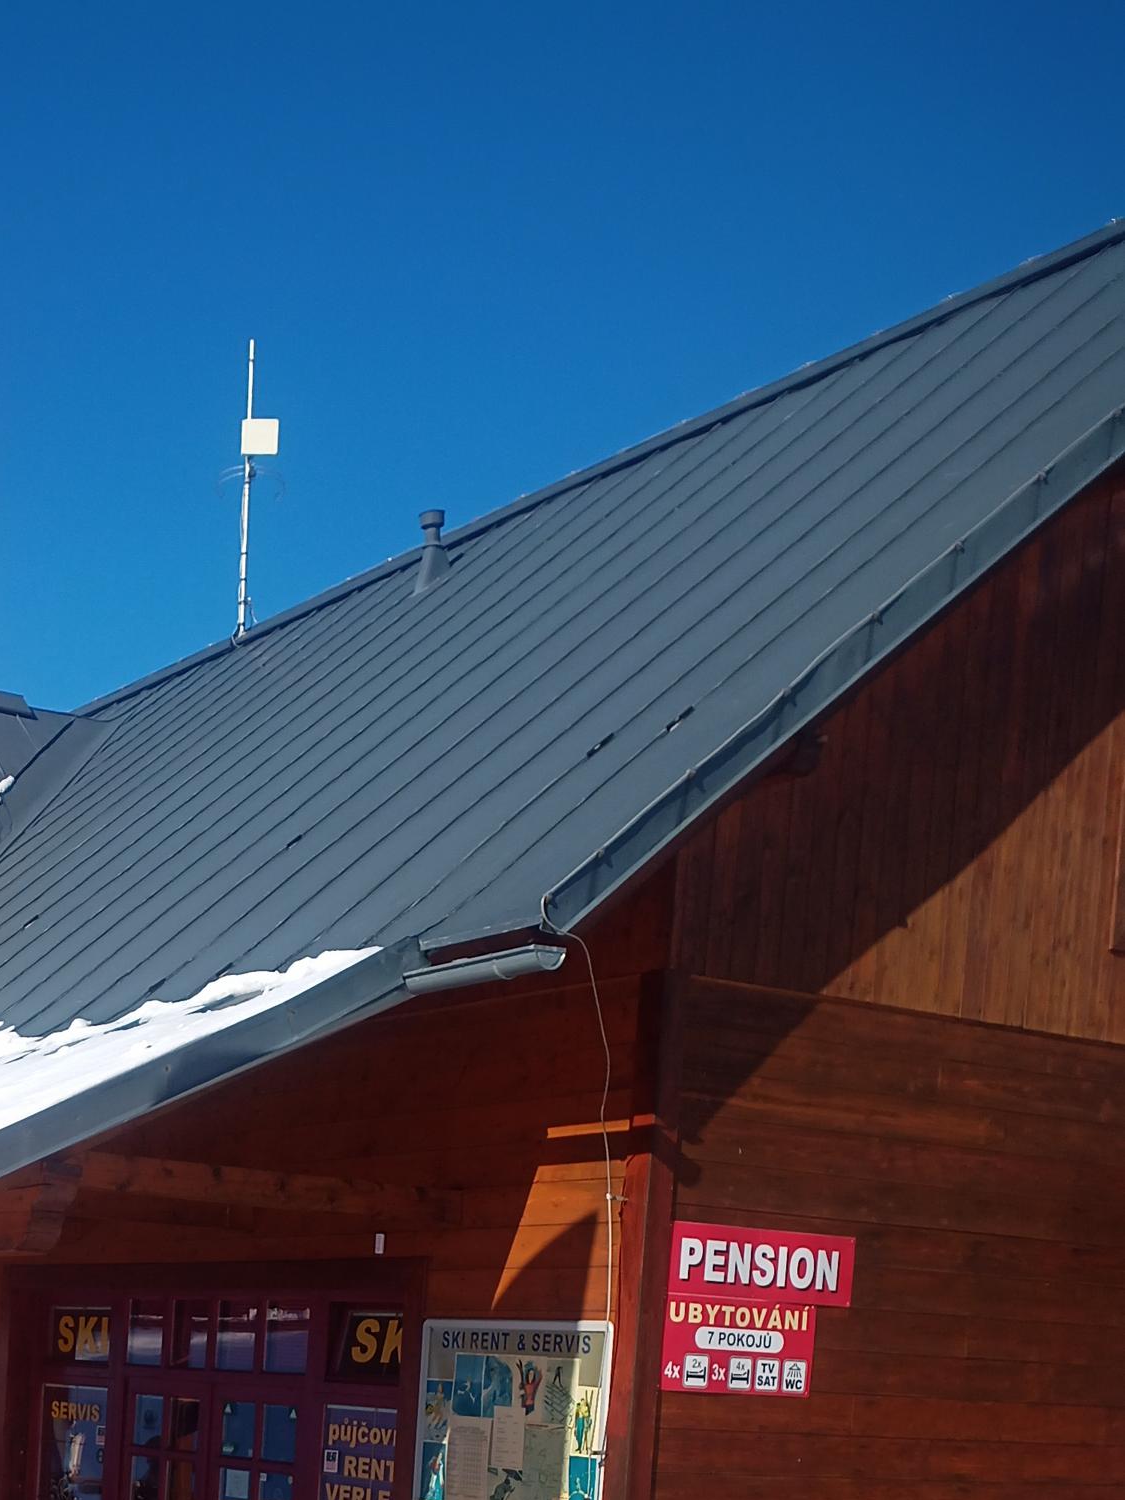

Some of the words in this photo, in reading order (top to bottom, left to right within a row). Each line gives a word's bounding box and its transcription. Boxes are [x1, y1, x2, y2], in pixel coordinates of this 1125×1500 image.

[679, 1237, 840, 1292] PENSION
[669, 1301, 810, 1331] UBYTOVÁNÍ
[58, 1315, 109, 1355] SKI
[442, 1330, 466, 1348] SKI
[470, 1331, 510, 1350] RENT
[517, 1333, 526, 1351] &
[531, 1333, 591, 1354] SERVIS
[708, 1331, 714, 1346] 7
[718, 1332, 772, 1348] POKOJŮ
[664, 1361, 680, 1379] 4x
[711, 1363, 726, 1381] 3x
[761, 1363, 775, 1373] TV
[757, 1375, 777, 1387] SAT
[785, 1379, 802, 1390] WC
[51, 1400, 100, 1422] SERVIS
[328, 1417, 396, 1448] půjčov
[343, 1455, 395, 1483] RENT
